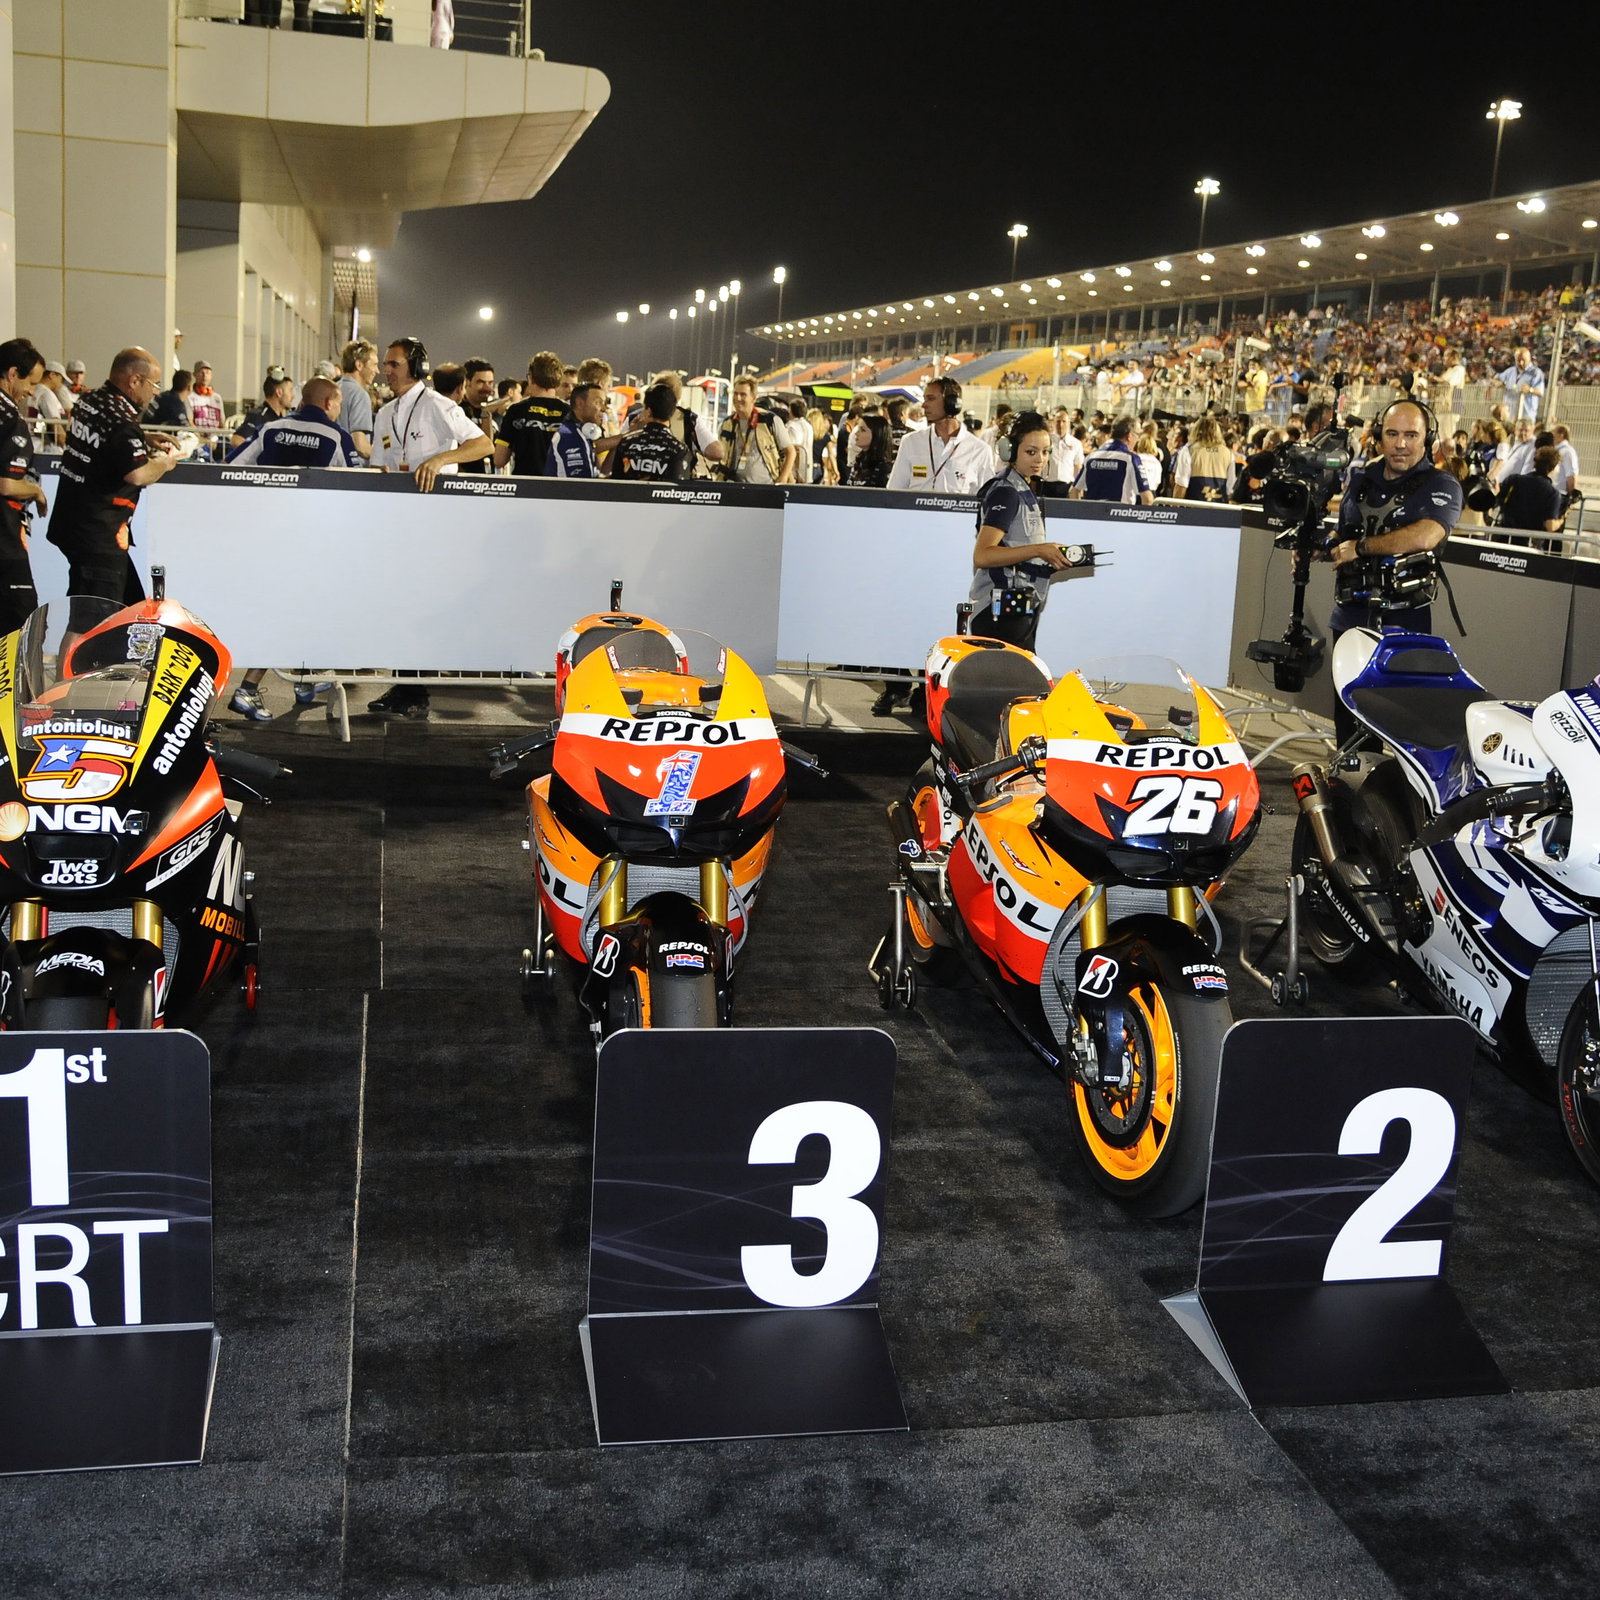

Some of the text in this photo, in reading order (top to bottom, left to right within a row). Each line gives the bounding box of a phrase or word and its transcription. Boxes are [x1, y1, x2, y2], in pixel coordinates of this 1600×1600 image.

[285, 432, 320, 447] YAMAHA
[220, 470, 300, 484] motogp.com
[443, 480, 517, 493] motogp.com
[651, 489, 722, 502] motogp.com
[1110, 508, 1179, 521] motogp.com
[1479, 552, 1528, 568] motogp.com
[152, 642, 196, 707] DARK DOG
[153, 667, 216, 776] antoniolupi
[655, 710, 692, 719] HONDA
[22, 719, 132, 740] antoniolupi
[600, 718, 746, 745] REPSOL
[19, 735, 140, 802] 5
[1095, 744, 1230, 770] REPSOL
[643, 749, 702, 816] 1
[1121, 774, 1224, 838] 26
[26, 804, 142, 835] NGM
[169, 824, 214, 866] GPS
[41, 872, 98, 884] dots
[658, 941, 709, 955] REPSOL
[666, 953, 705, 969] HRC
[1443, 907, 1500, 989] ENEOS
[35, 952, 105, 973] MEDIA
[1182, 964, 1228, 977] REPSOL
[1193, 976, 1229, 990] HRC
[1420, 951, 1483, 1029] YAMAHA
[0, 1047, 108, 1207] 1st
[1322, 1087, 1456, 1282] 2
[741, 1100, 881, 1308] 3
[0, 1218, 169, 1329] RT
